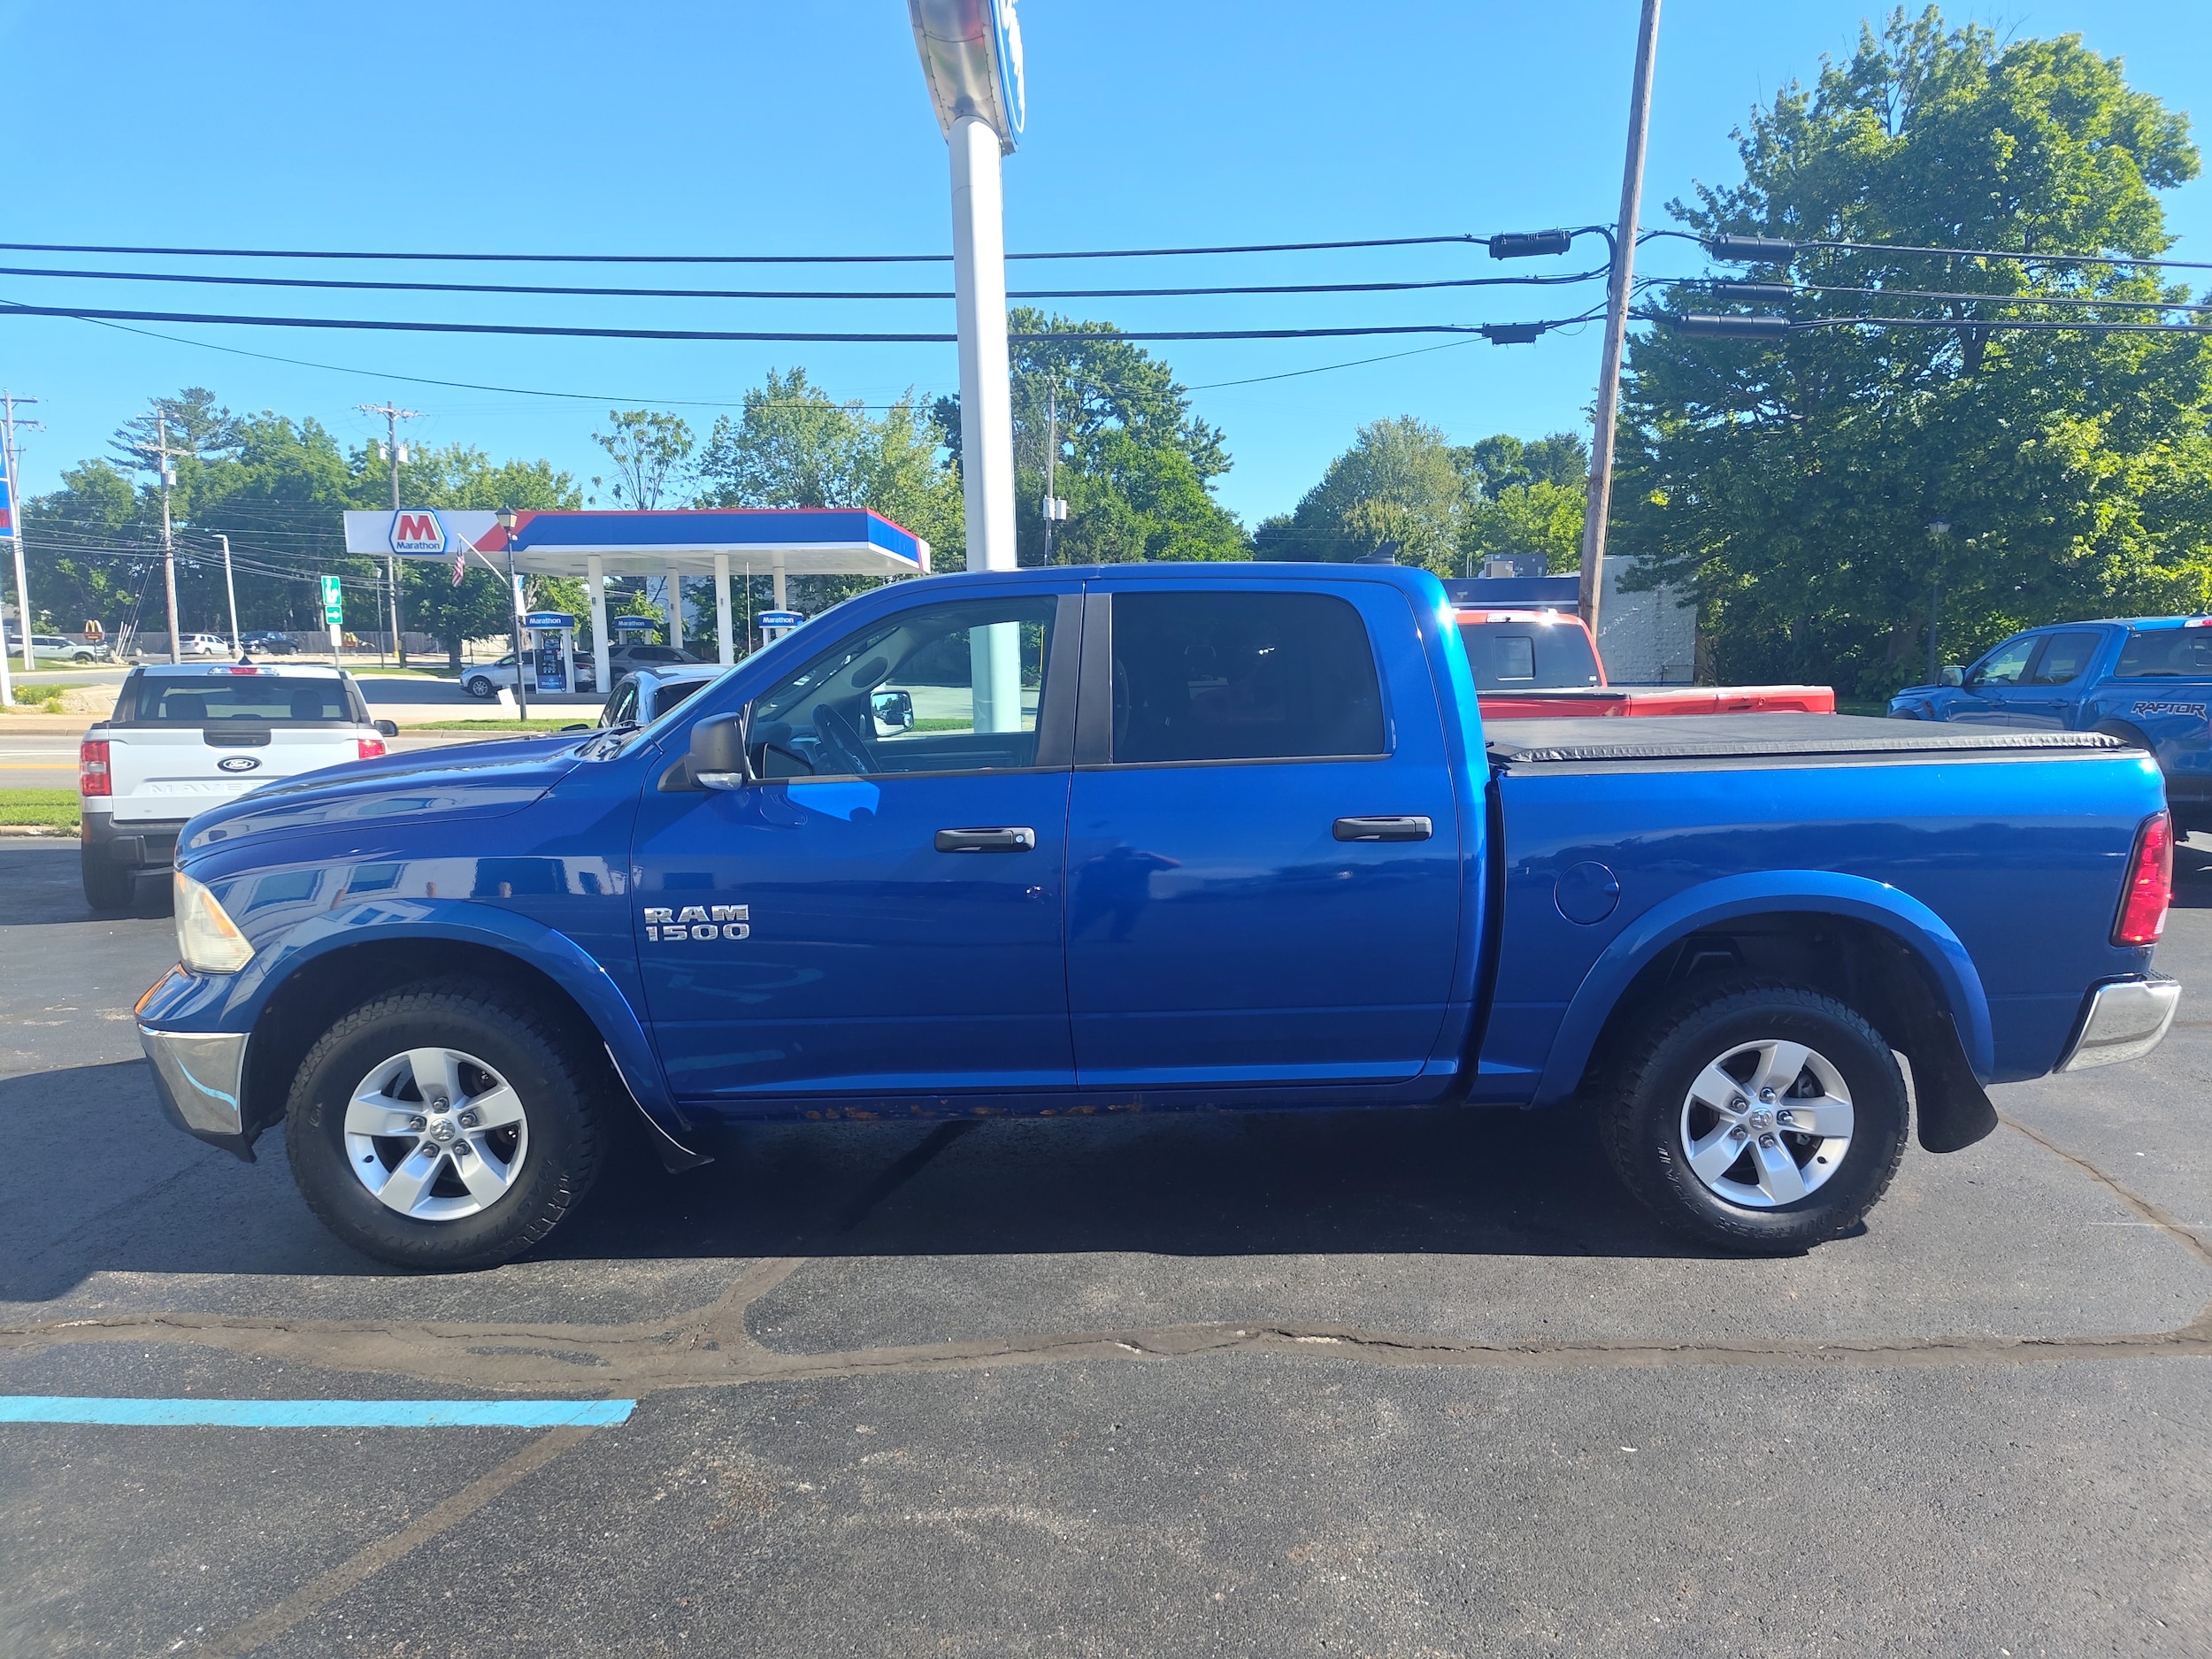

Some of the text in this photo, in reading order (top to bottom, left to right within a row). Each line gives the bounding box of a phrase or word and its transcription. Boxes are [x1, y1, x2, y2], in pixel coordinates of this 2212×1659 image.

[397, 515, 438, 541] M
[2131, 701, 2208, 723] RAPTOR
[643, 904, 750, 924] RAM
[646, 923, 750, 942] 1500
